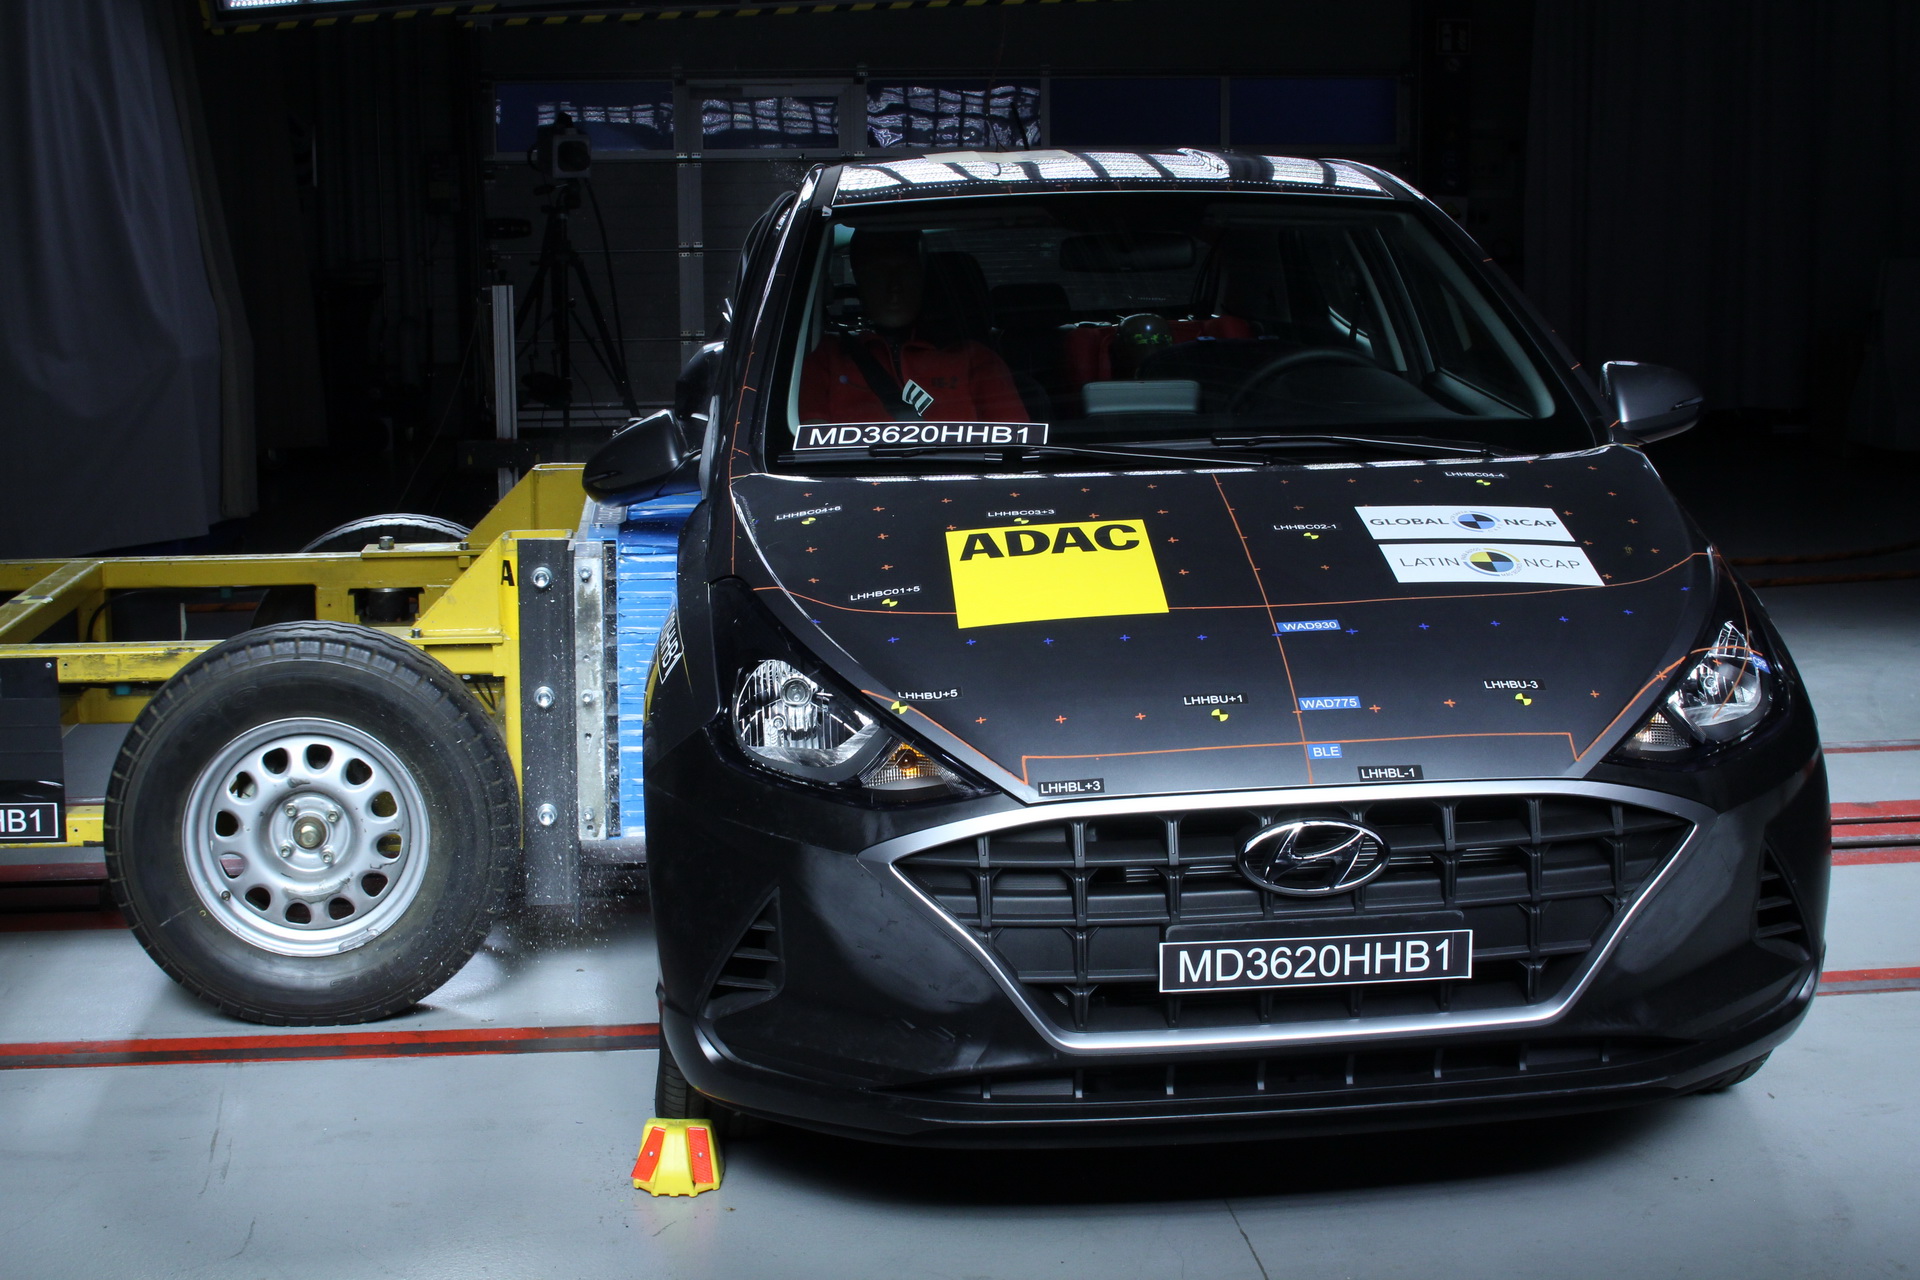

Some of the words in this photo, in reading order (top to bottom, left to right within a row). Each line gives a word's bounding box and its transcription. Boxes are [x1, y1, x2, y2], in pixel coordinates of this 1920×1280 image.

[809, 425, 1030, 446] MD3620HHB1
[987, 509, 1055, 517] LHHBC03+3
[1369, 518, 1450, 526] GLOBAL
[1503, 518, 1558, 528] NCAP
[960, 524, 1140, 561] ADAC
[1400, 557, 1460, 568] LATIN
[1523, 558, 1581, 570] NCAP
[501, 560, 515, 587] A
[850, 586, 920, 600] LHHBC01+5
[1283, 621, 1337, 631] WAD930
[1484, 680, 1538, 690] LHHBU-3
[898, 689, 958, 699] LHHBU+5
[1184, 695, 1243, 706] LHHBU+1
[1301, 698, 1358, 709] WAD775
[1313, 746, 1340, 758] BLE
[1361, 767, 1416, 779] LHHBL-1
[1040, 782, 1100, 794] LHHBL+3
[0, 808, 41, 833] B1
[1179, 938, 1450, 983] MD3620HHB1
